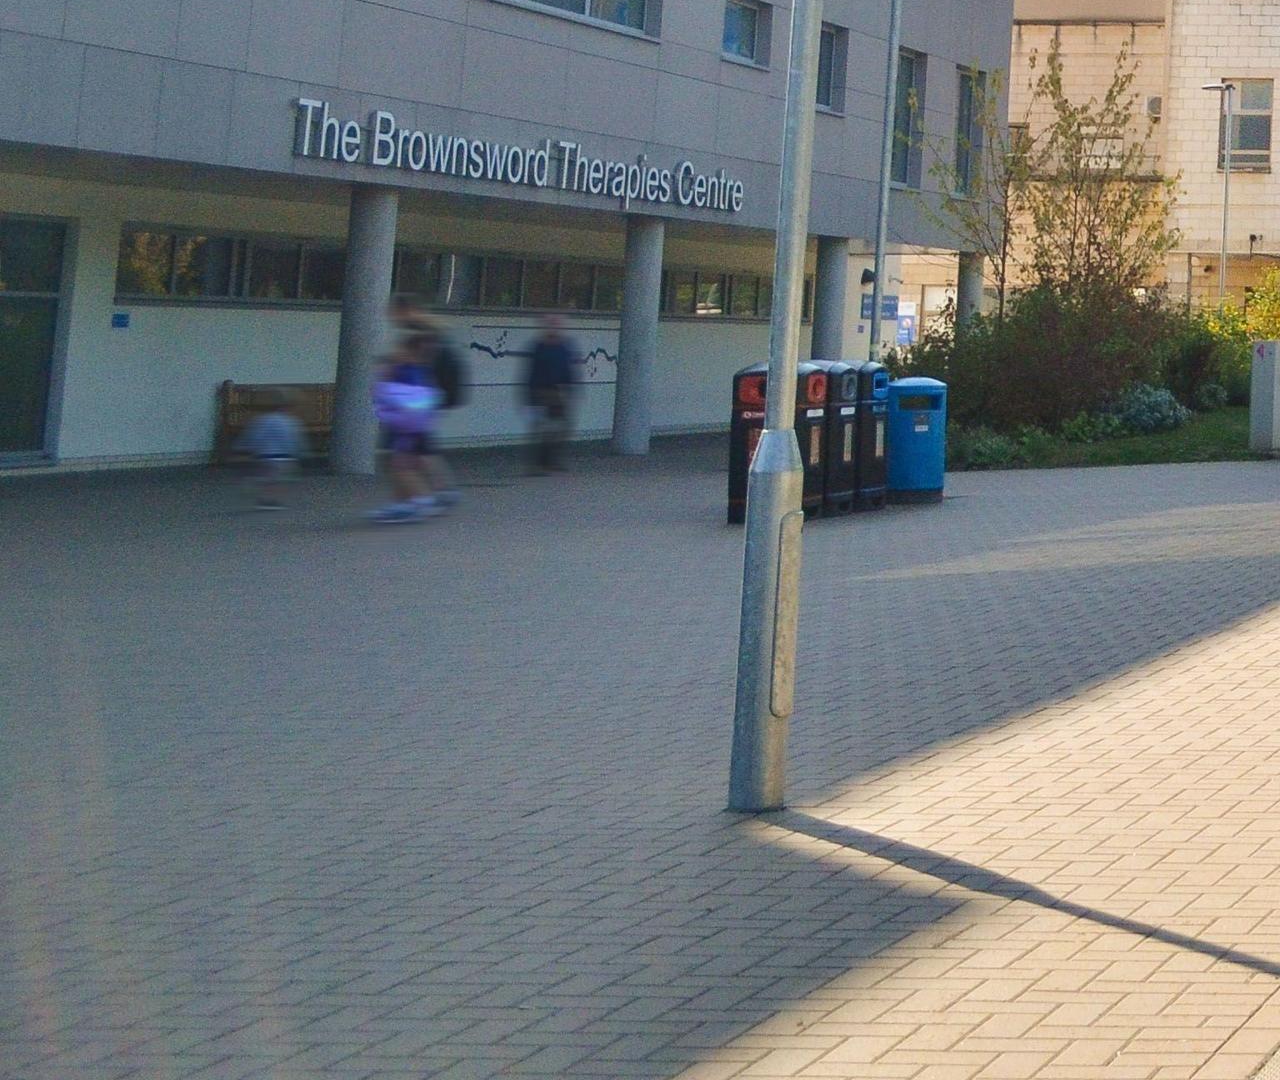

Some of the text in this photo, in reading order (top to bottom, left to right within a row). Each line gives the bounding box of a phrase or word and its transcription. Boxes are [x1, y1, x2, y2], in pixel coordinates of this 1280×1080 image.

[298, 98, 744, 212] The Brownsword Therapies Centre
